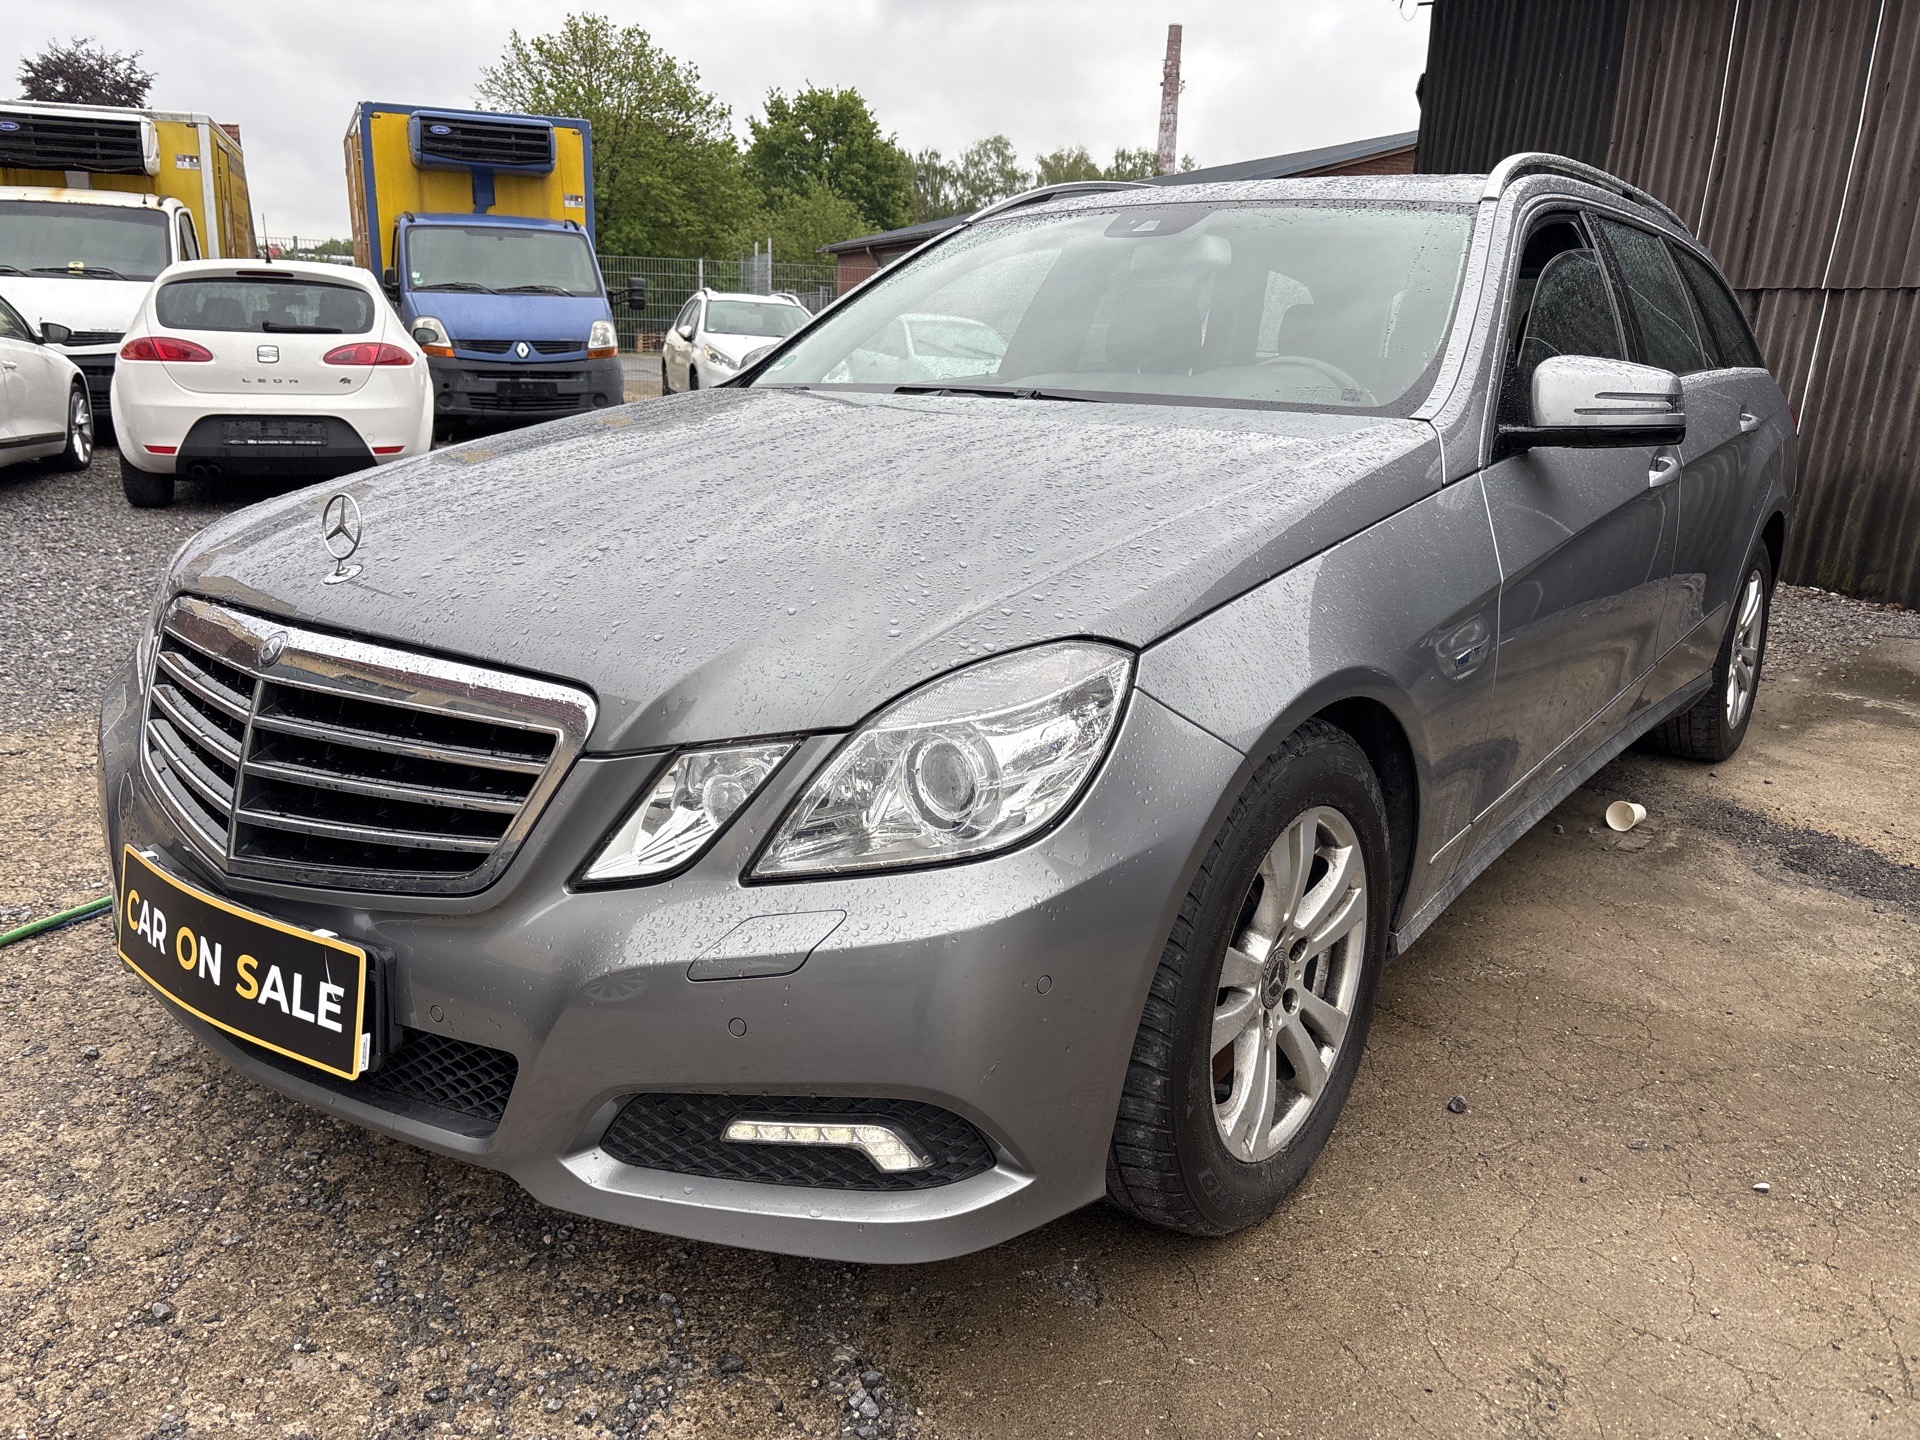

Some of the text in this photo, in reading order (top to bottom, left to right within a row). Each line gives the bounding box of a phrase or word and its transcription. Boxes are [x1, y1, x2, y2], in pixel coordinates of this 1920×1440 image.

[127, 889, 345, 1033] CAR ON SALE
